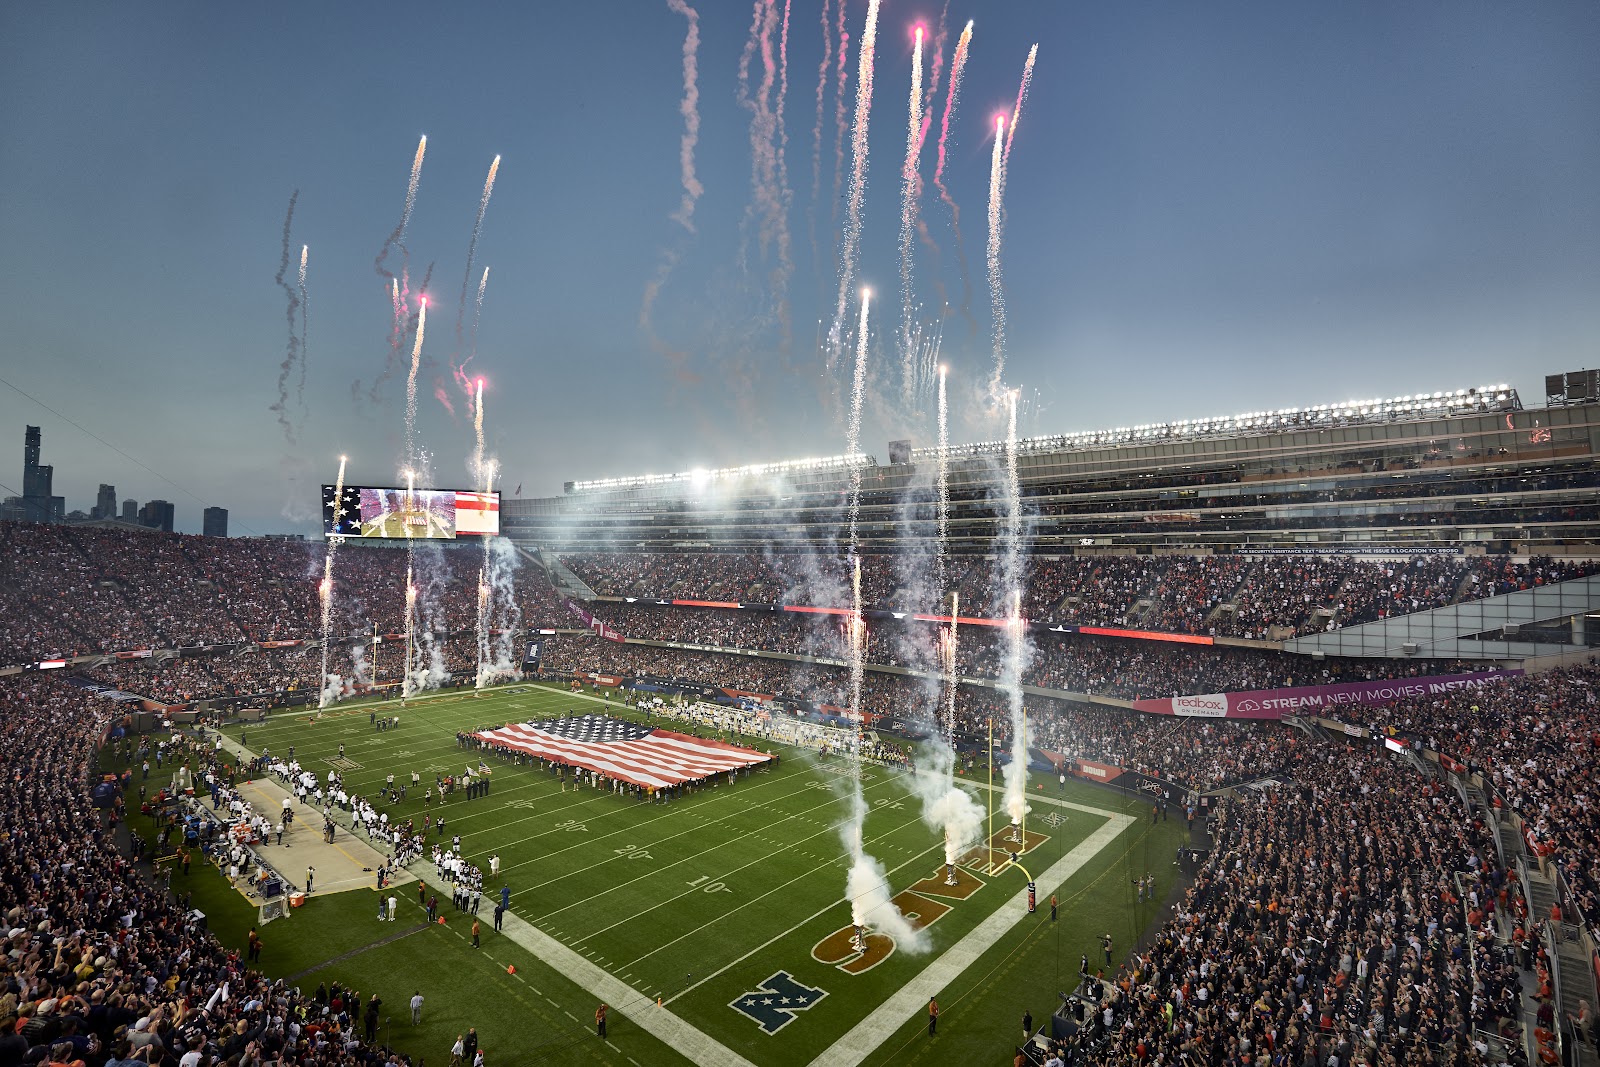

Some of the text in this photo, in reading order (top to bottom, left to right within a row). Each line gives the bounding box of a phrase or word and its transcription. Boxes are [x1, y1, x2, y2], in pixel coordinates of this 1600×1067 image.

[1262, 695, 1323, 710] STREAM
[1326, 691, 1362, 704] NEW
[1366, 684, 1425, 701] MOVIES
[614, 844, 650, 860] 20
[686, 875, 726, 894] 10
